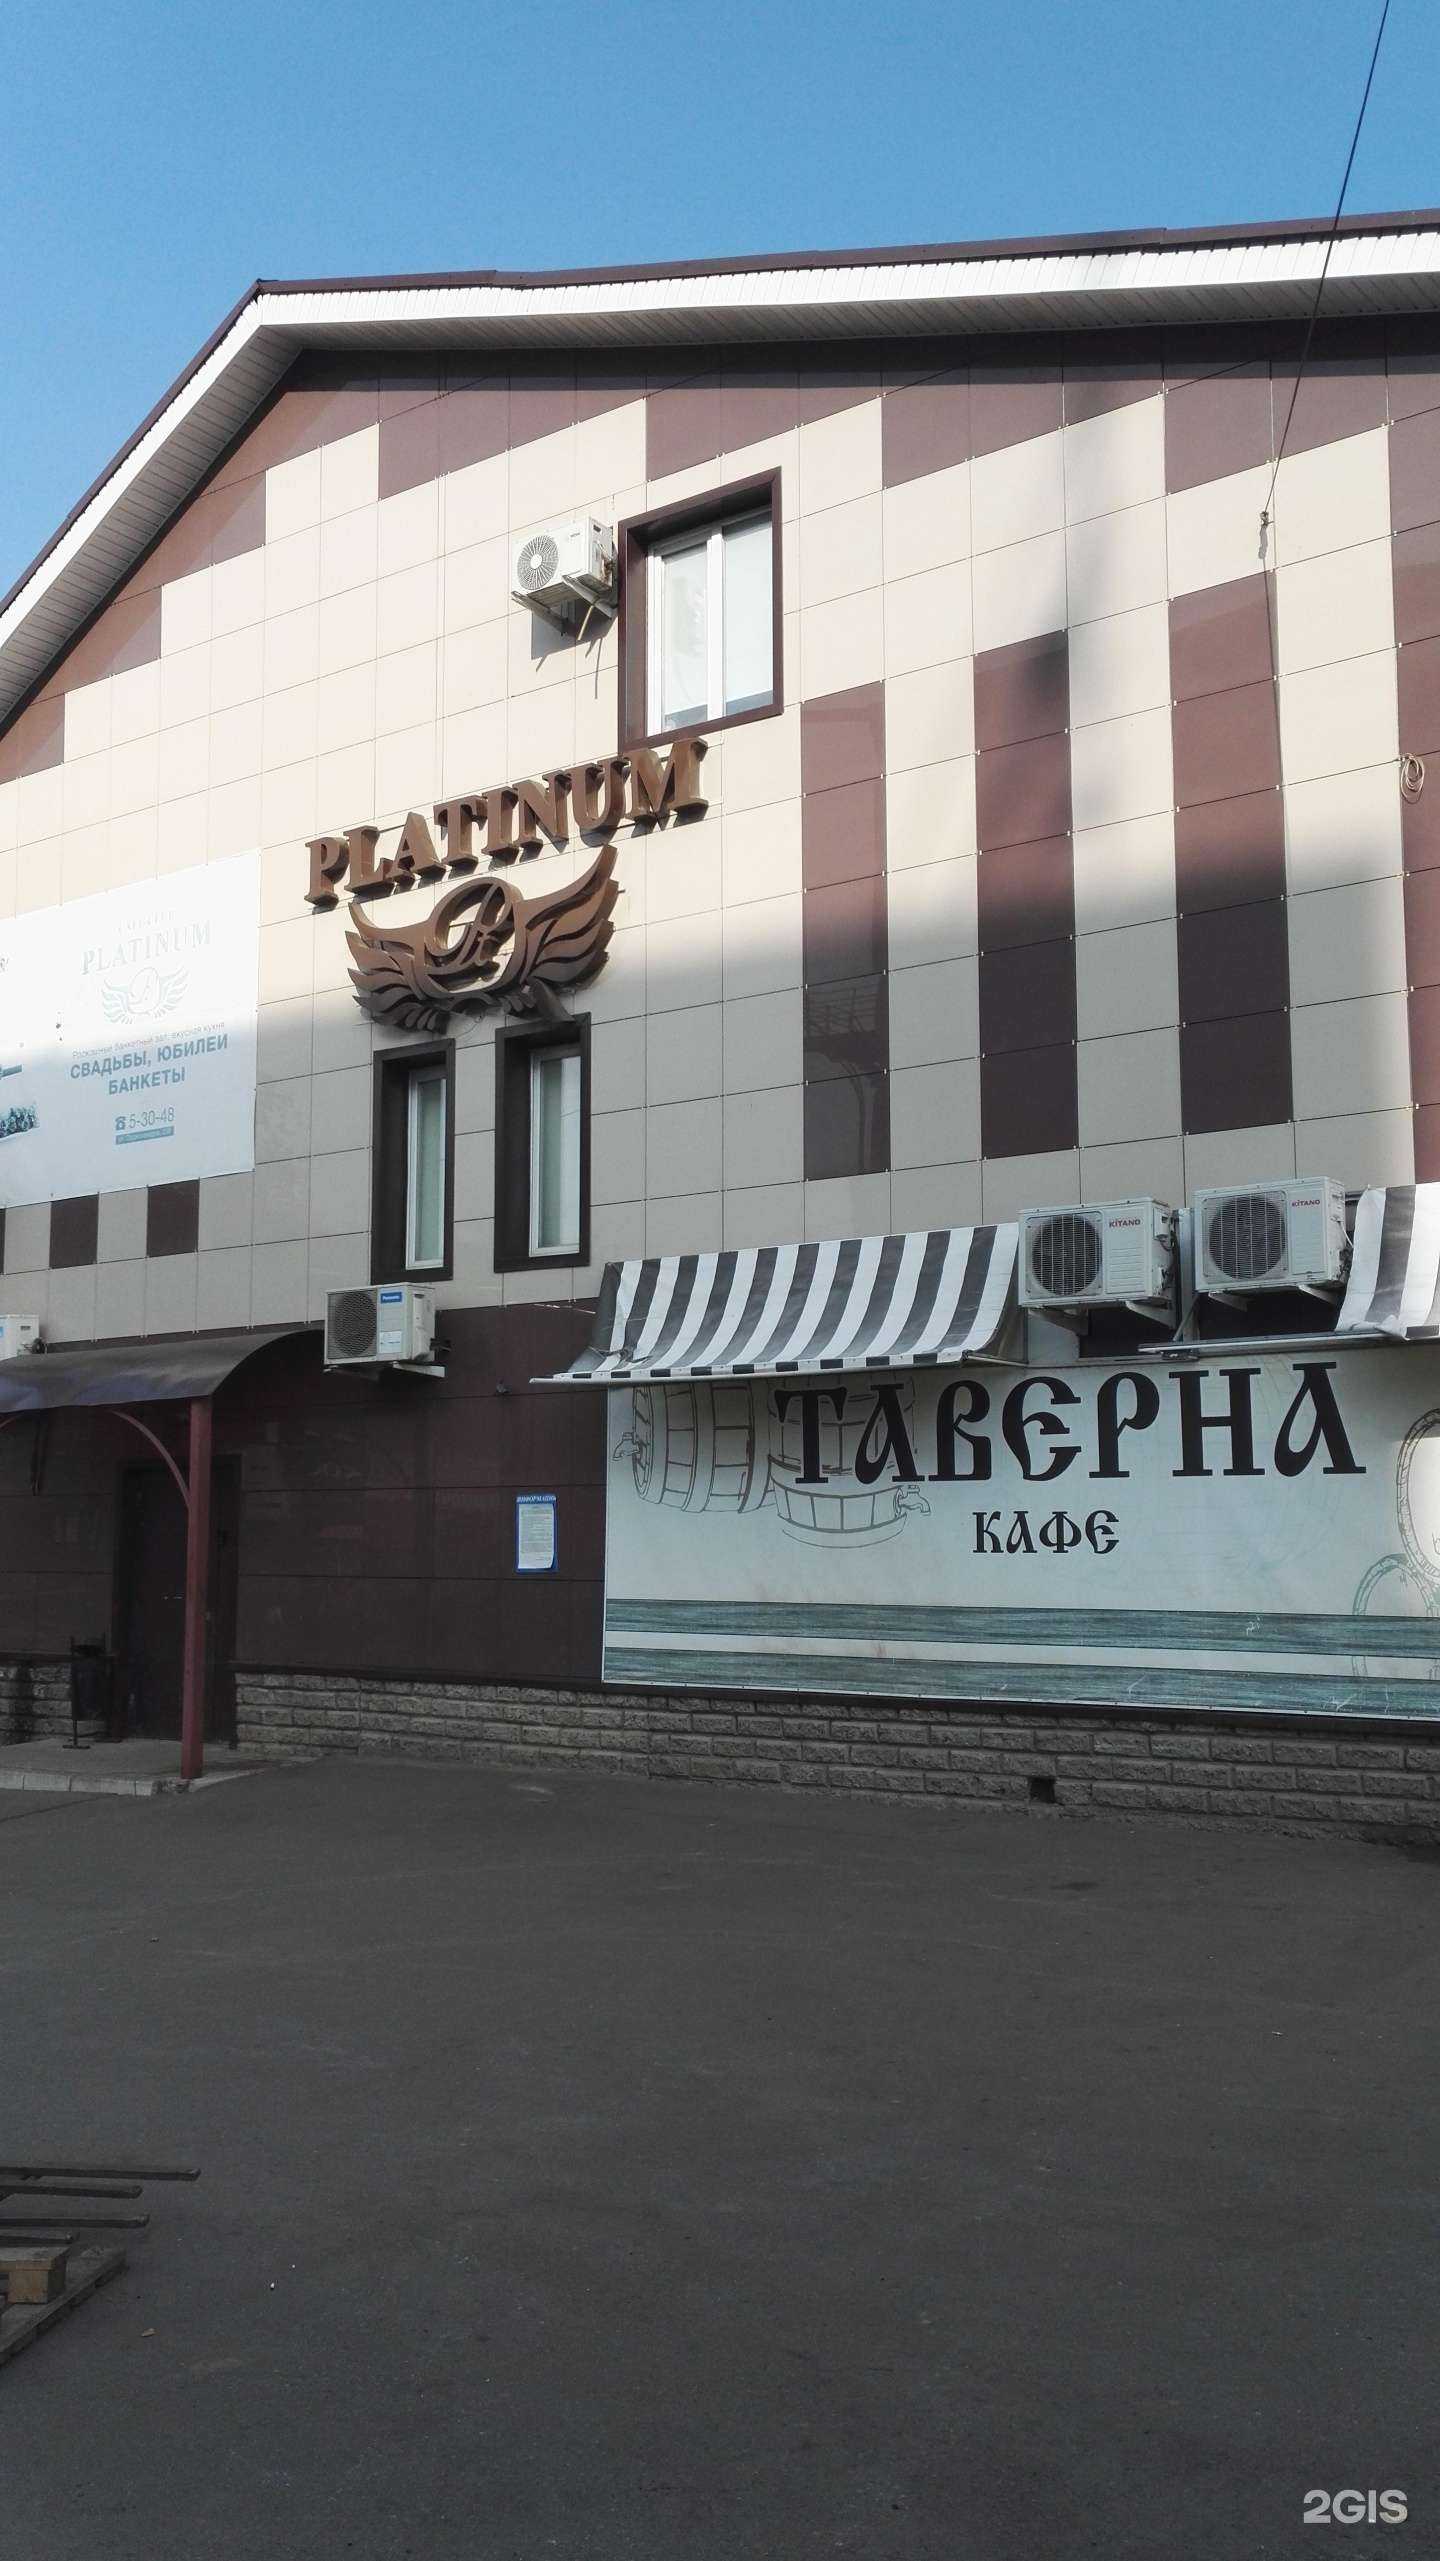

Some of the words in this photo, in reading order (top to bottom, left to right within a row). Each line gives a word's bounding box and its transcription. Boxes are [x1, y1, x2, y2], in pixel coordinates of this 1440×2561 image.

[303, 736, 709, 908] PLATINUM
[81, 919, 210, 976] PLATINUM
[70, 1050, 152, 1079] СВАДЬБЫ,
[108, 1066, 186, 1095] БАНКЕТЫ
[128, 1106, 175, 1129] 5-30-48
[1291, 1199, 1321, 1208] KITANO
[1108, 1218, 1141, 1229] KITANO
[773, 1361, 1367, 1485] ТАВЕРНА
[971, 1509, 1120, 1555] КАФЕ
